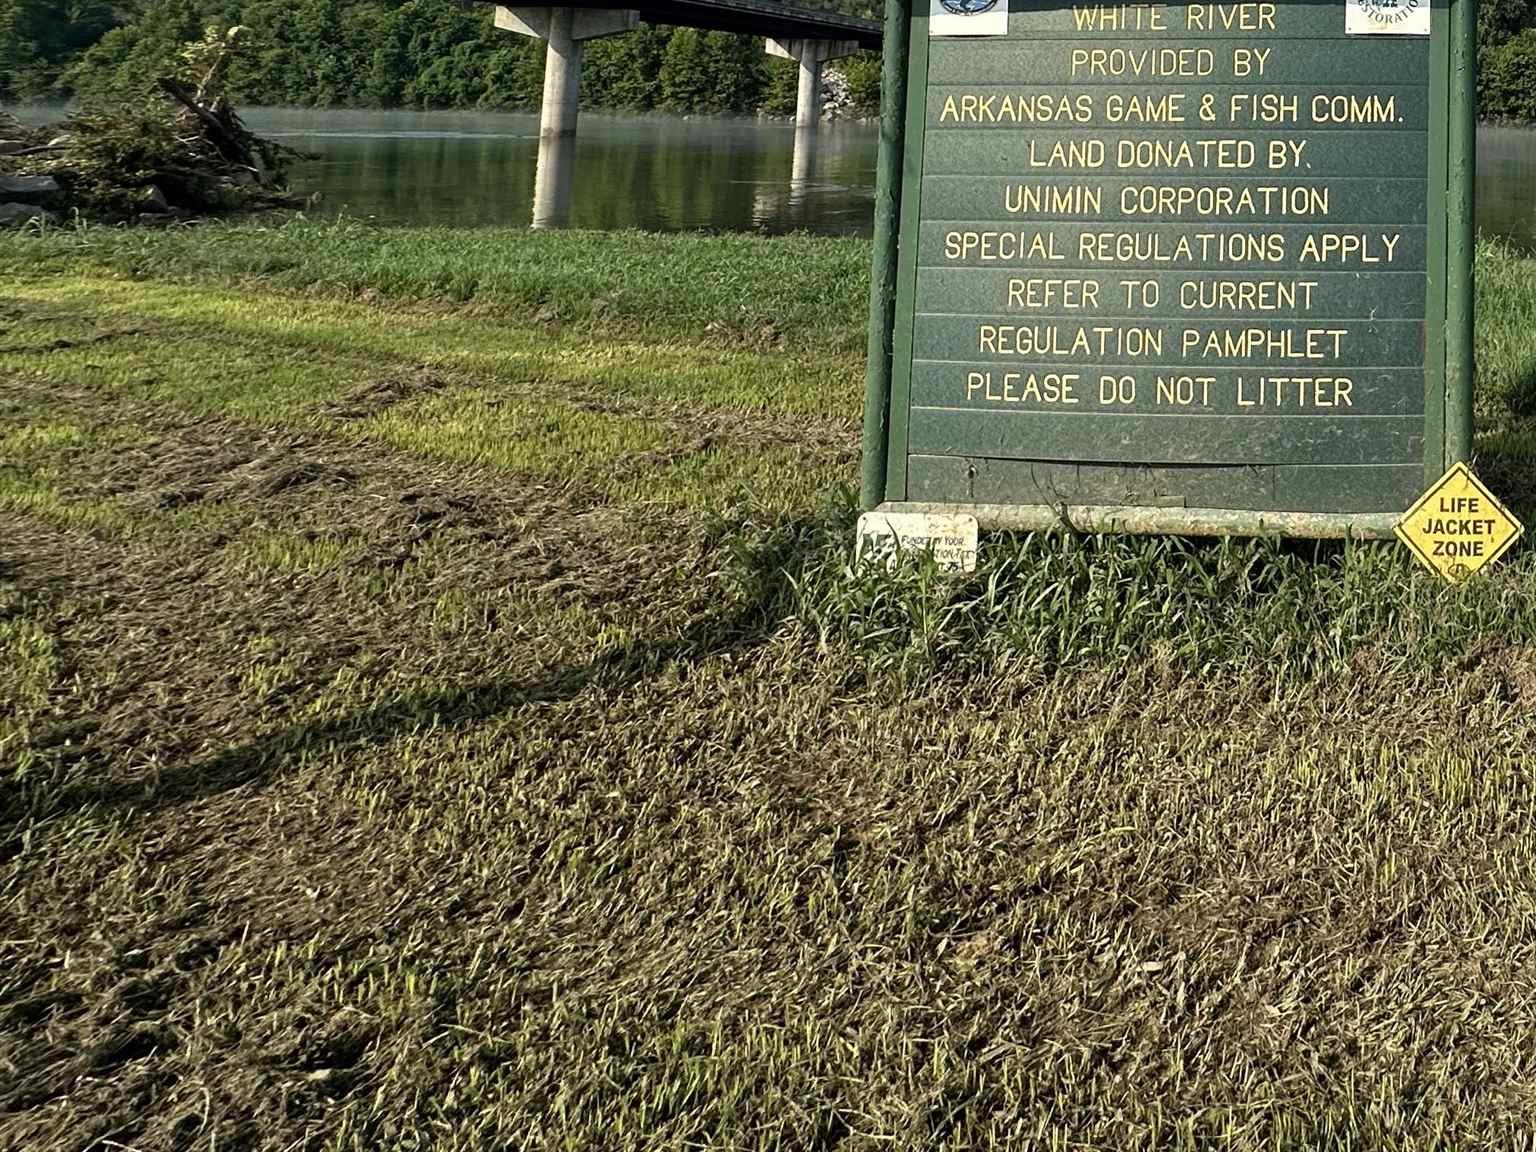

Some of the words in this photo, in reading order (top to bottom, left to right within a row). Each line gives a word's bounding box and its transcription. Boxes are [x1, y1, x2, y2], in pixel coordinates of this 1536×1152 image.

[1073, 3, 1168, 32] WHITE
[1187, 3, 1276, 30] RIVER
[1071, 48, 1214, 76] PROVIDED
[1234, 47, 1271, 76] BY
[939, 94, 1093, 123] ARKANSAS
[1106, 94, 1186, 122] GAME
[1198, 93, 1216, 121] &
[1230, 94, 1298, 122] FISH
[1311, 95, 1404, 123] COMM.
[1030, 139, 1105, 168] LAND
[1117, 139, 1255, 168] DONATED
[1005, 184, 1102, 214] UNIMIN
[1120, 185, 1329, 216] CORPORATION
[944, 231, 1065, 260] SPECIAL
[1078, 232, 1285, 262] REGULATIONS
[1299, 234, 1400, 263] APPLY
[1007, 279, 1099, 309] REFER
[1119, 280, 1159, 309] TO
[1180, 281, 1319, 310] CURRENT
[979, 325, 1162, 356] REGULATION
[1182, 328, 1348, 359] PAMPHLET
[967, 372, 1080, 404] PLEASE
[1099, 375, 1136, 405] DO
[1156, 376, 1217, 406] NOT
[1237, 377, 1353, 407] LITTER
[1440, 497, 1479, 513] LIFE
[1422, 519, 1495, 535] JACKET
[1432, 541, 1484, 557] ZONE
